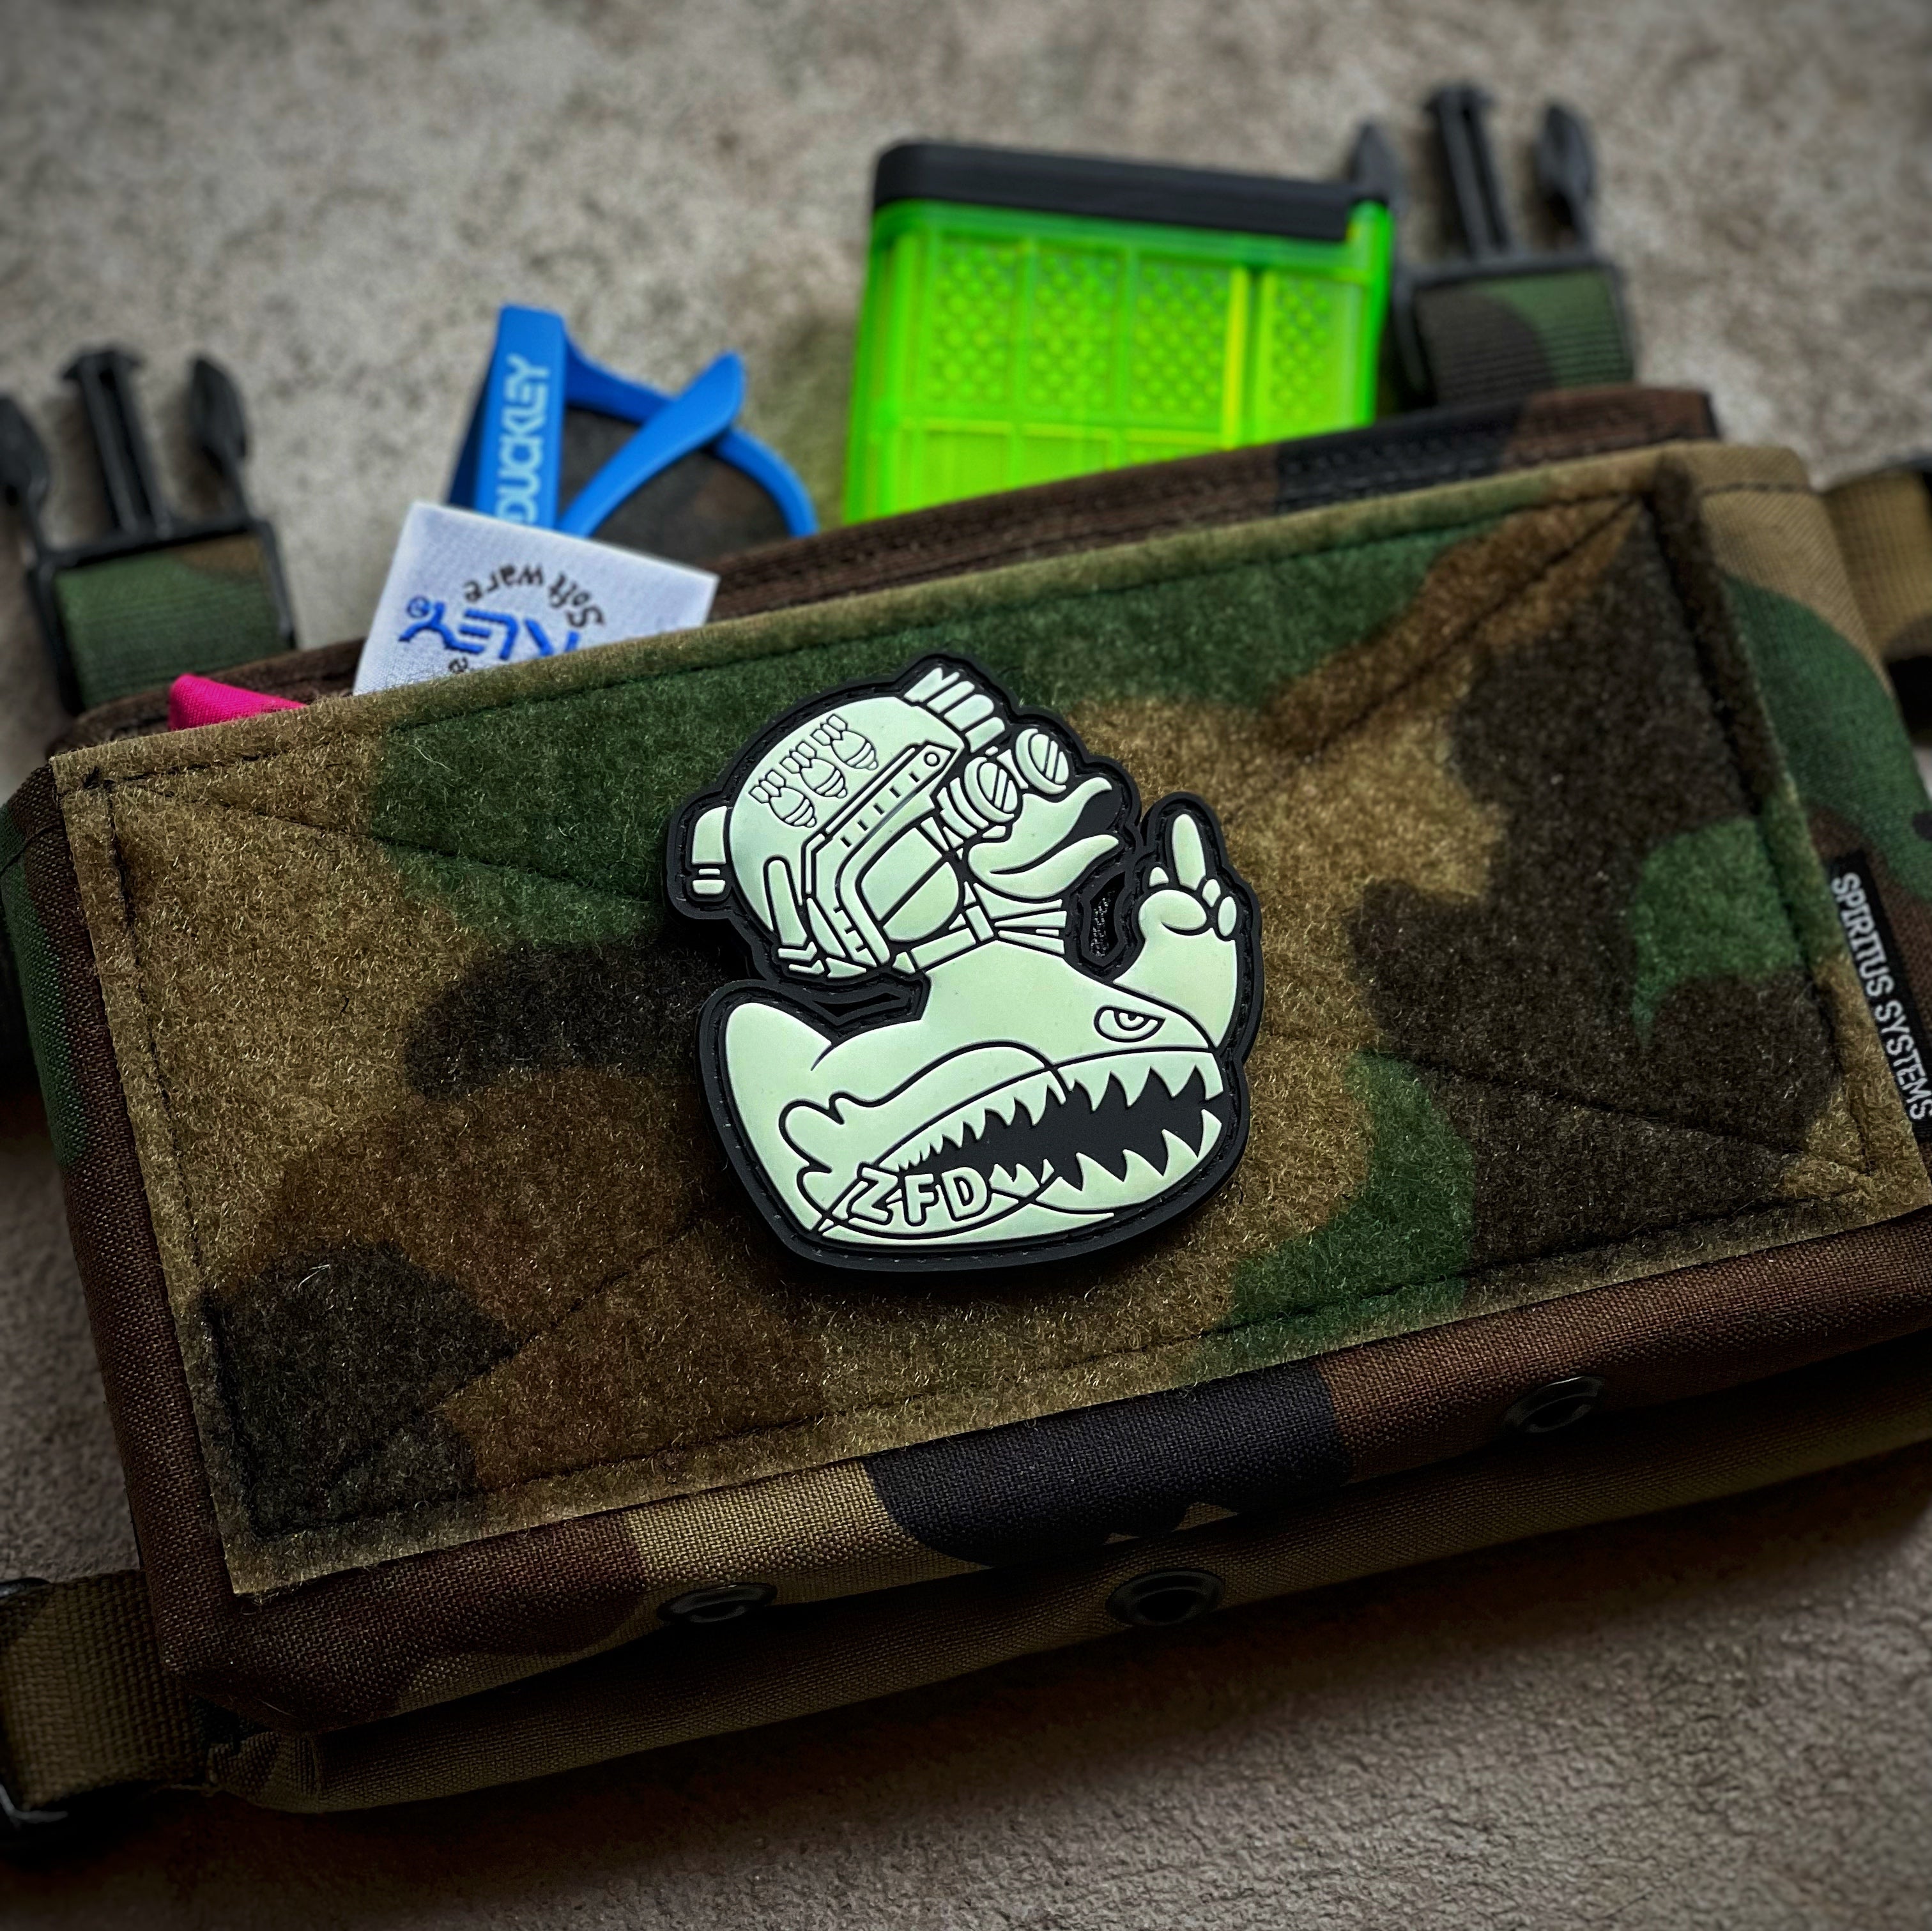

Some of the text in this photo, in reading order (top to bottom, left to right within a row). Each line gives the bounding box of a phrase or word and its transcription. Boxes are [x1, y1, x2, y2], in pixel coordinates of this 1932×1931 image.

[1831, 871, 1932, 1120] SPIRITUS SYSTEMS
[850, 1166, 988, 1223] ZFD
